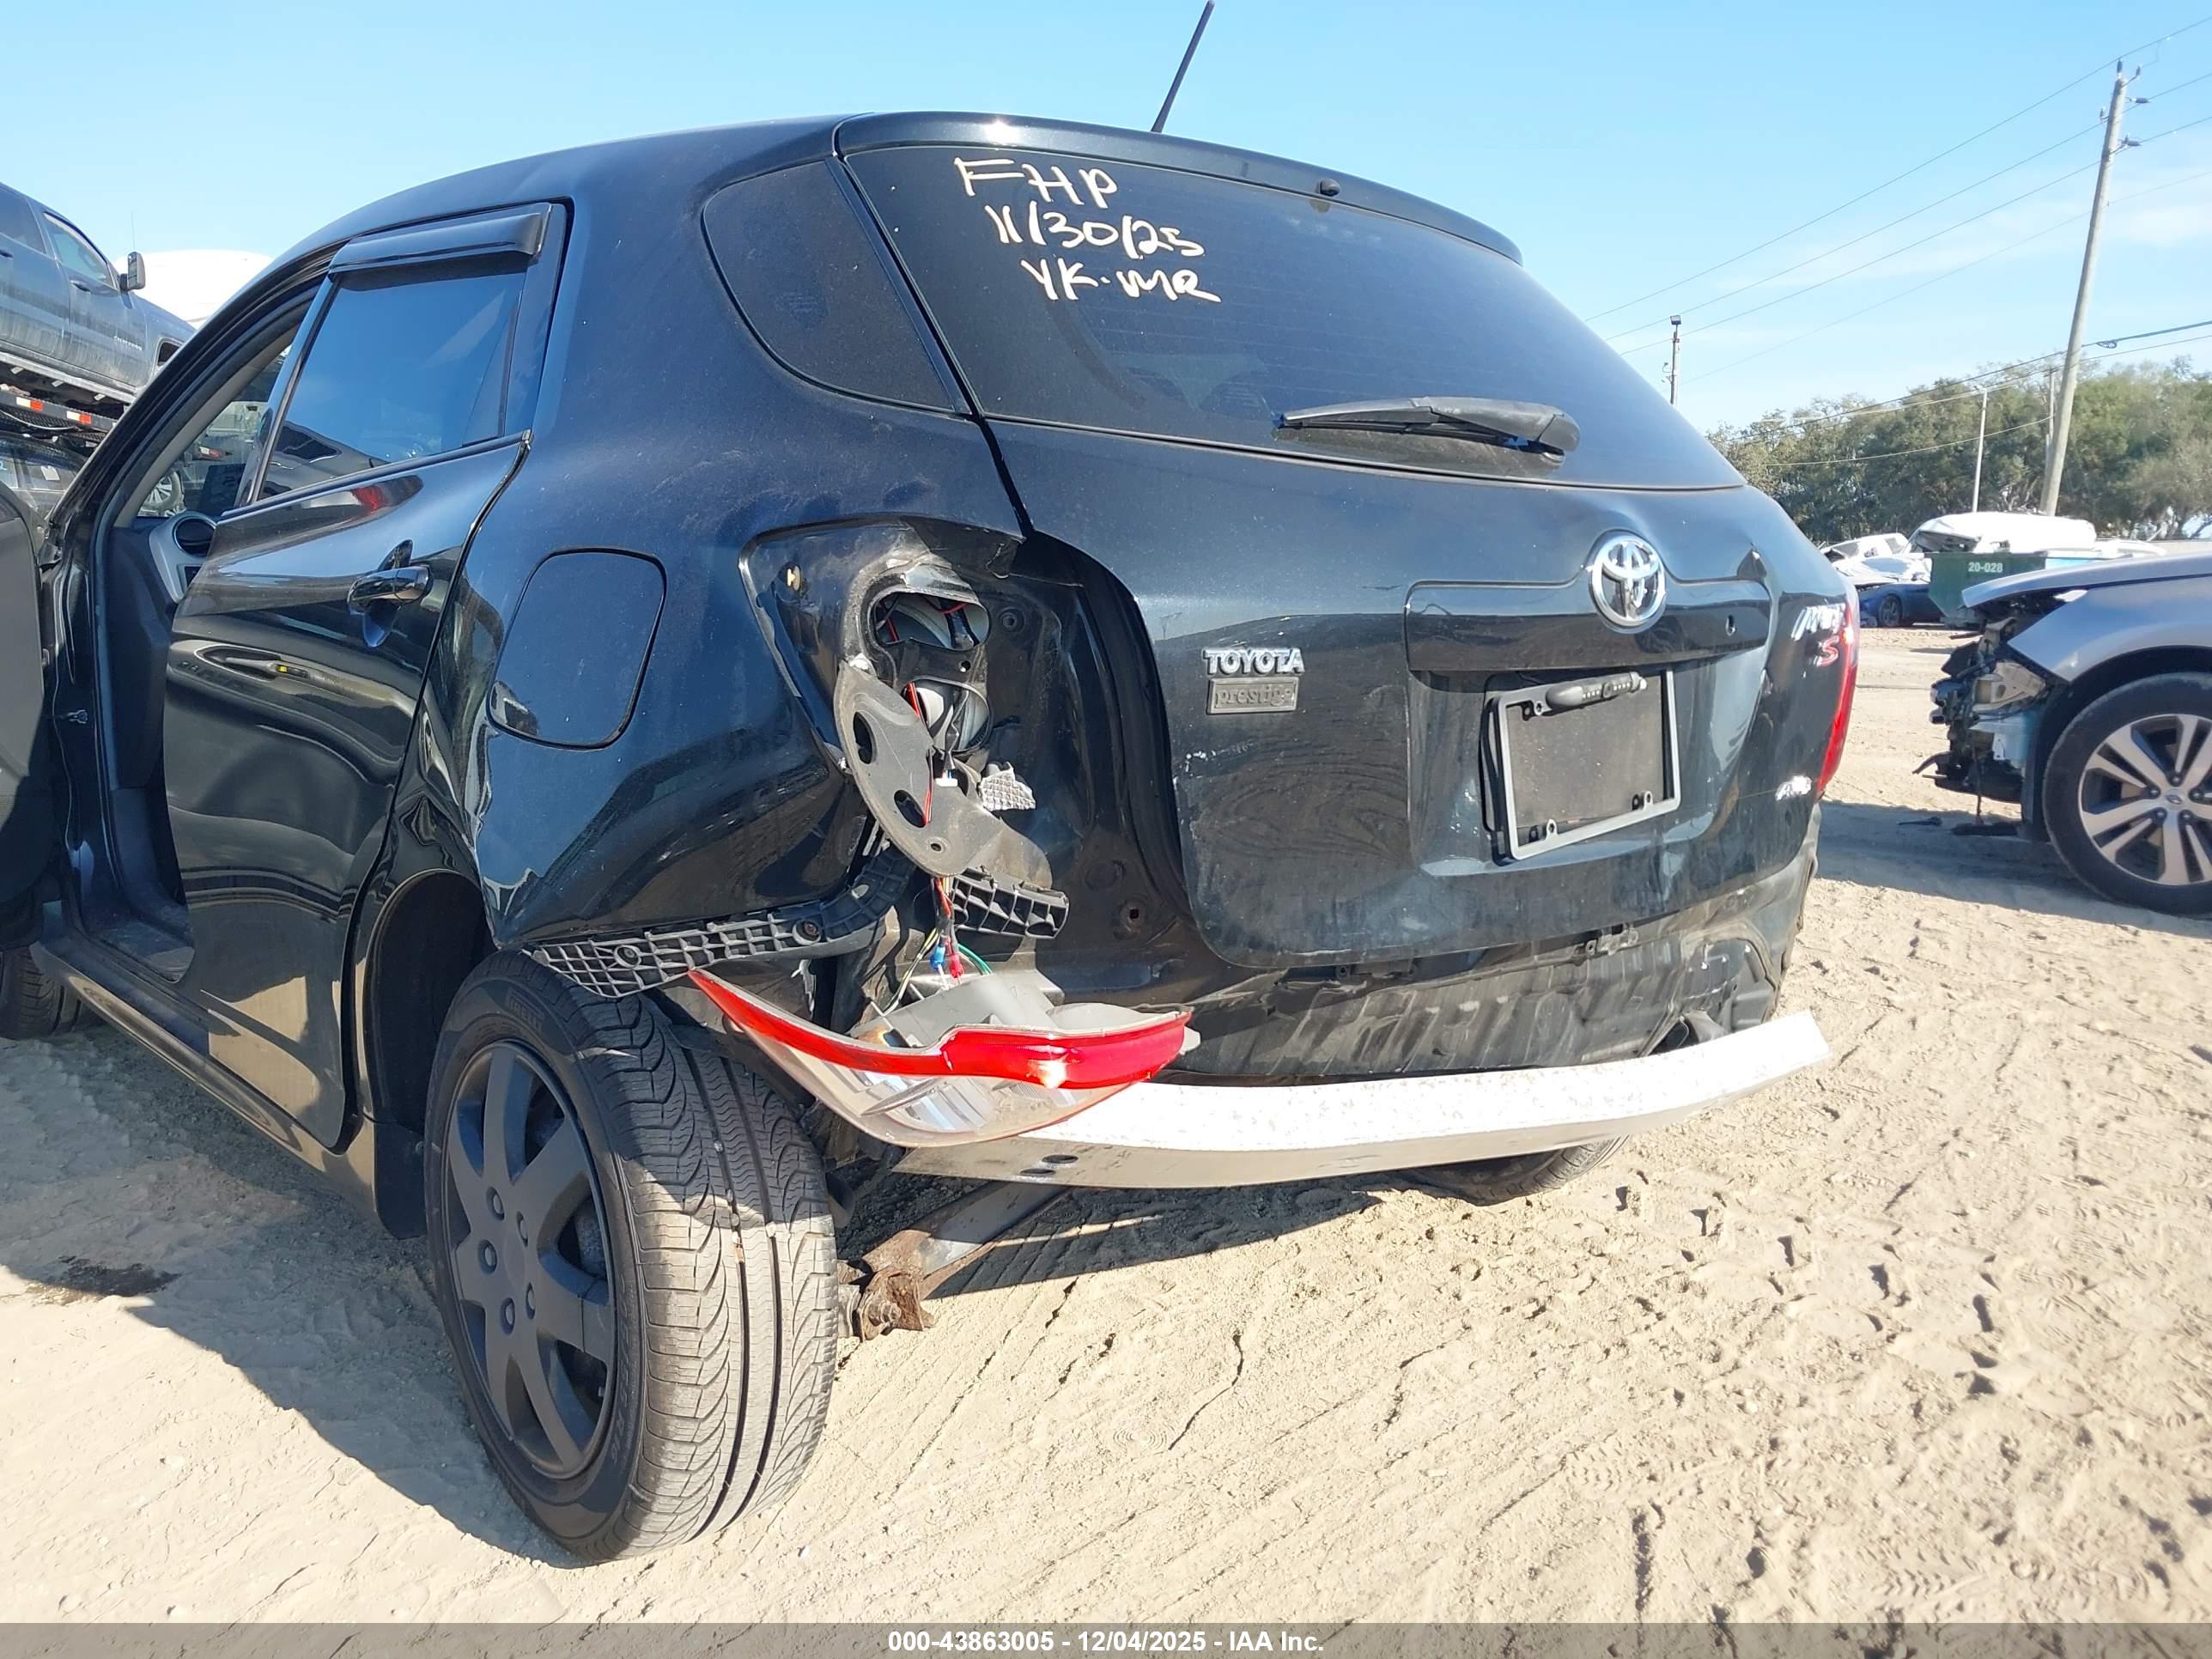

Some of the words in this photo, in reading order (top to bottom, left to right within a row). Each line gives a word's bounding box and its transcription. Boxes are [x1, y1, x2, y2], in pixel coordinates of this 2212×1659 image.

[954, 156, 1118, 209] FHP
[984, 200, 1205, 259] 11/30/25
[1967, 562, 2003, 574] 20-028
[1202, 647, 1305, 675] TOYOTA
